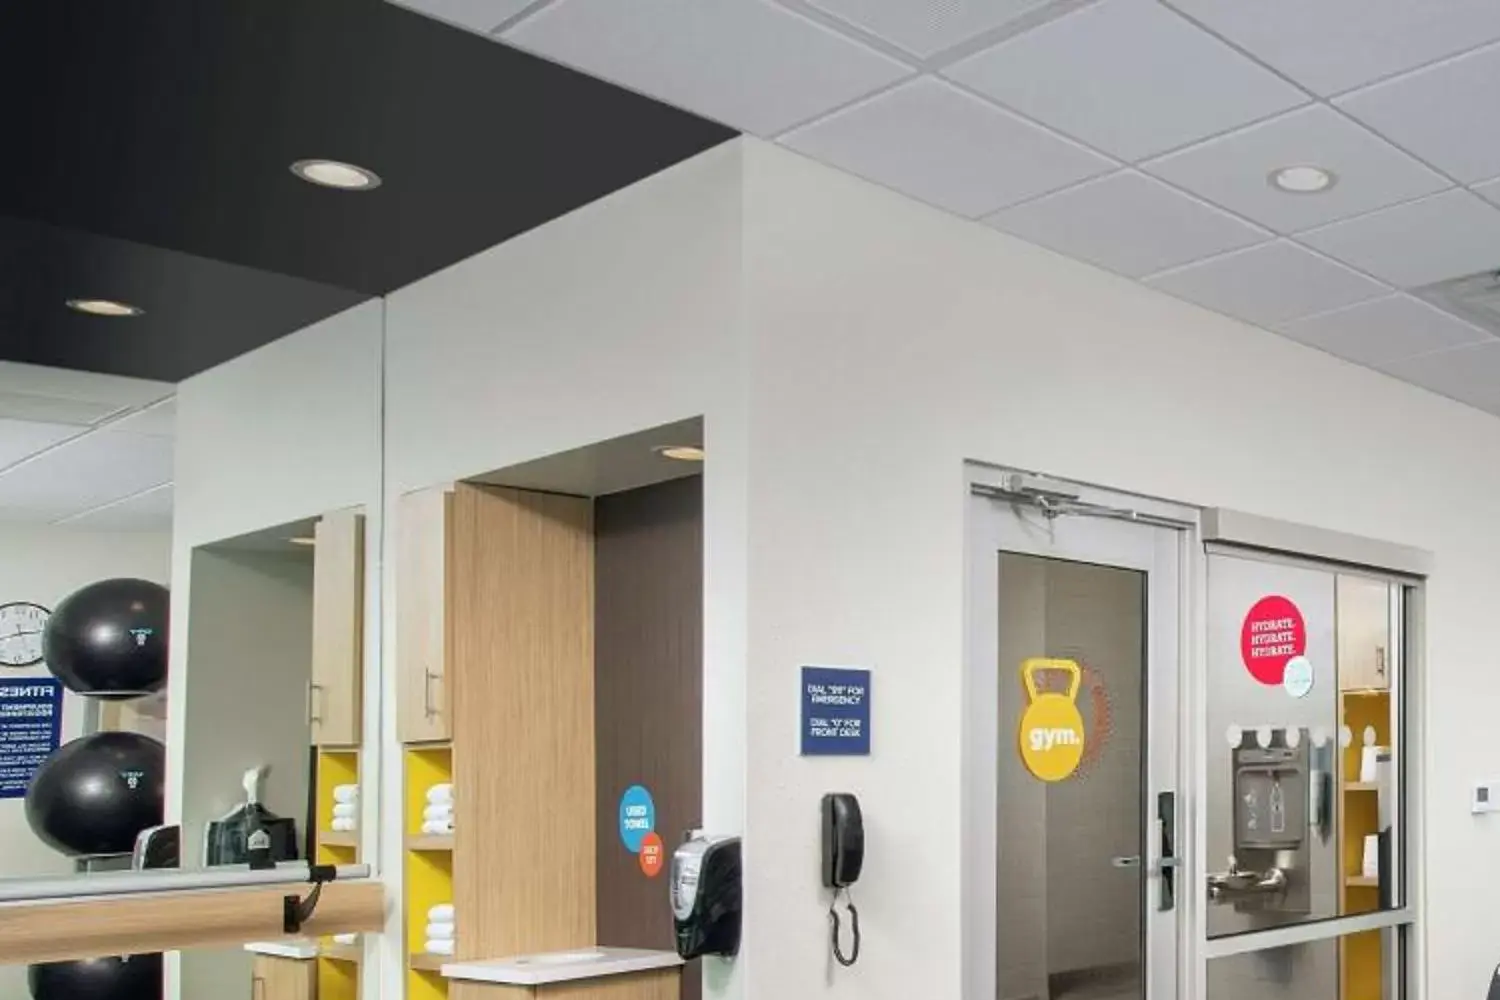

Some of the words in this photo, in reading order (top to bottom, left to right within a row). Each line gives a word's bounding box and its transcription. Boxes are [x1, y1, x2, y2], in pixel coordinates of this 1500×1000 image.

[1251, 618, 1296, 633] HYDRATE.
[1251, 631, 1296, 645] HYDRATE.
[1251, 643, 1296, 658] HYDRATE.
[811, 694, 861, 705] EMERGENCY
[810, 727, 838, 737] FRONT
[1029, 727, 1080, 752] gym.
